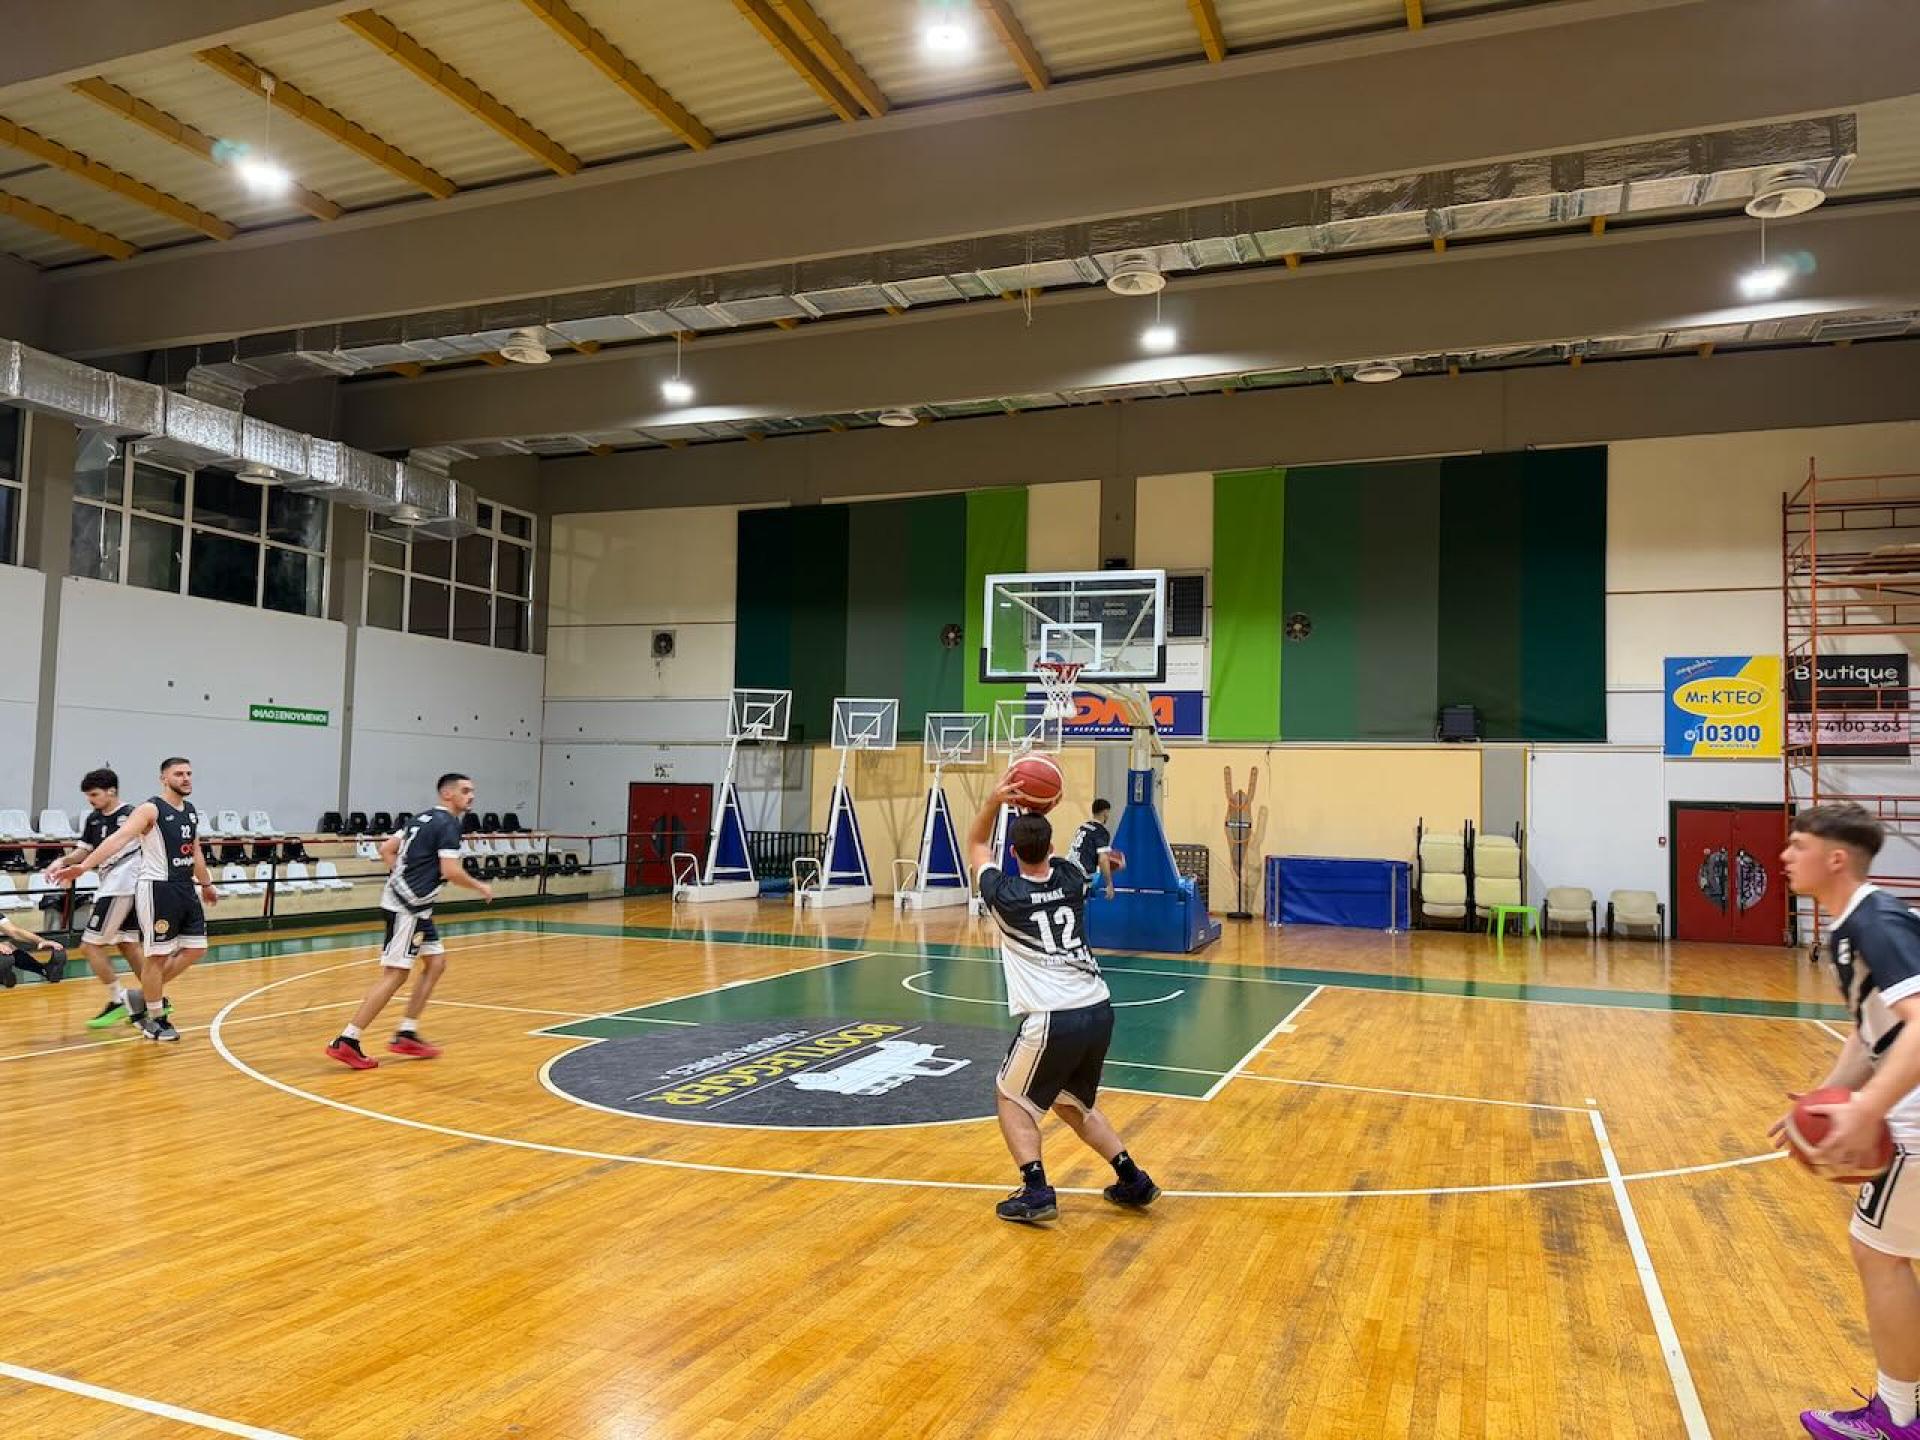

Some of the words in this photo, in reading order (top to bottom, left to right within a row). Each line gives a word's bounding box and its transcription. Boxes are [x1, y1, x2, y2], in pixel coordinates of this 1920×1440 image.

[1685, 691, 1709, 704] Mr.
[1712, 690, 1762, 704] KTEO
[251, 708, 327, 724] ΦΙΛΟΞΕΝΟΥΜΕΝΟΙ
[1695, 724, 1761, 742] 10300
[1824, 721, 1866, 733] 4100
[1871, 721, 1902, 733] 363
[180, 824, 192, 839] 22
[1029, 905, 1082, 953] 12
[645, 1023, 904, 1105] BOOTLEGGER
